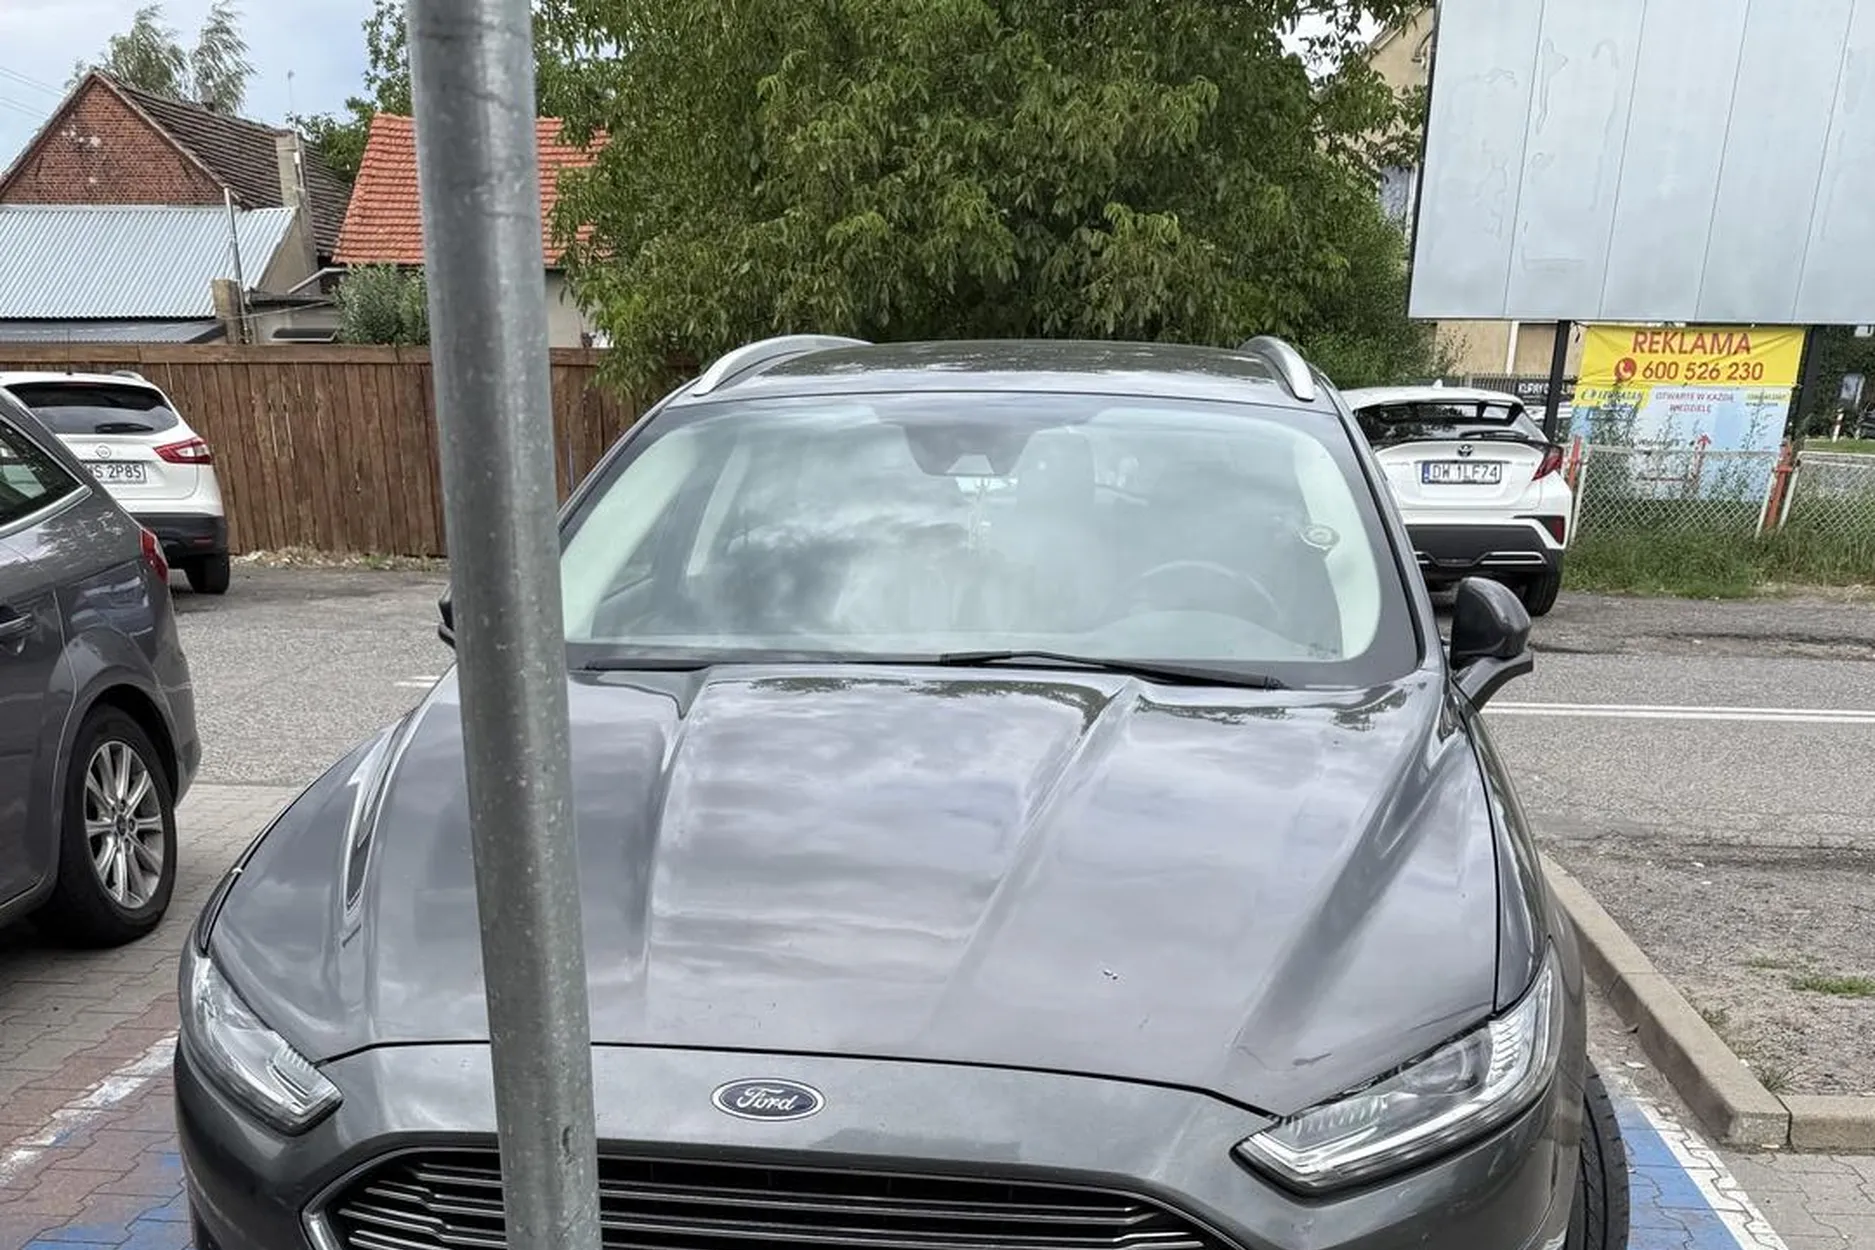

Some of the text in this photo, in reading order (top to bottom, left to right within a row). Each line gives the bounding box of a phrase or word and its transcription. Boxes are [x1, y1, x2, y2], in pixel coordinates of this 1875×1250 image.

[1632, 331, 1751, 355] REKLAMA
[1642, 361, 1764, 381] 600 526 230
[1432, 464, 1498, 479] DW 1LF74
[736, 1086, 798, 1110] Ford
